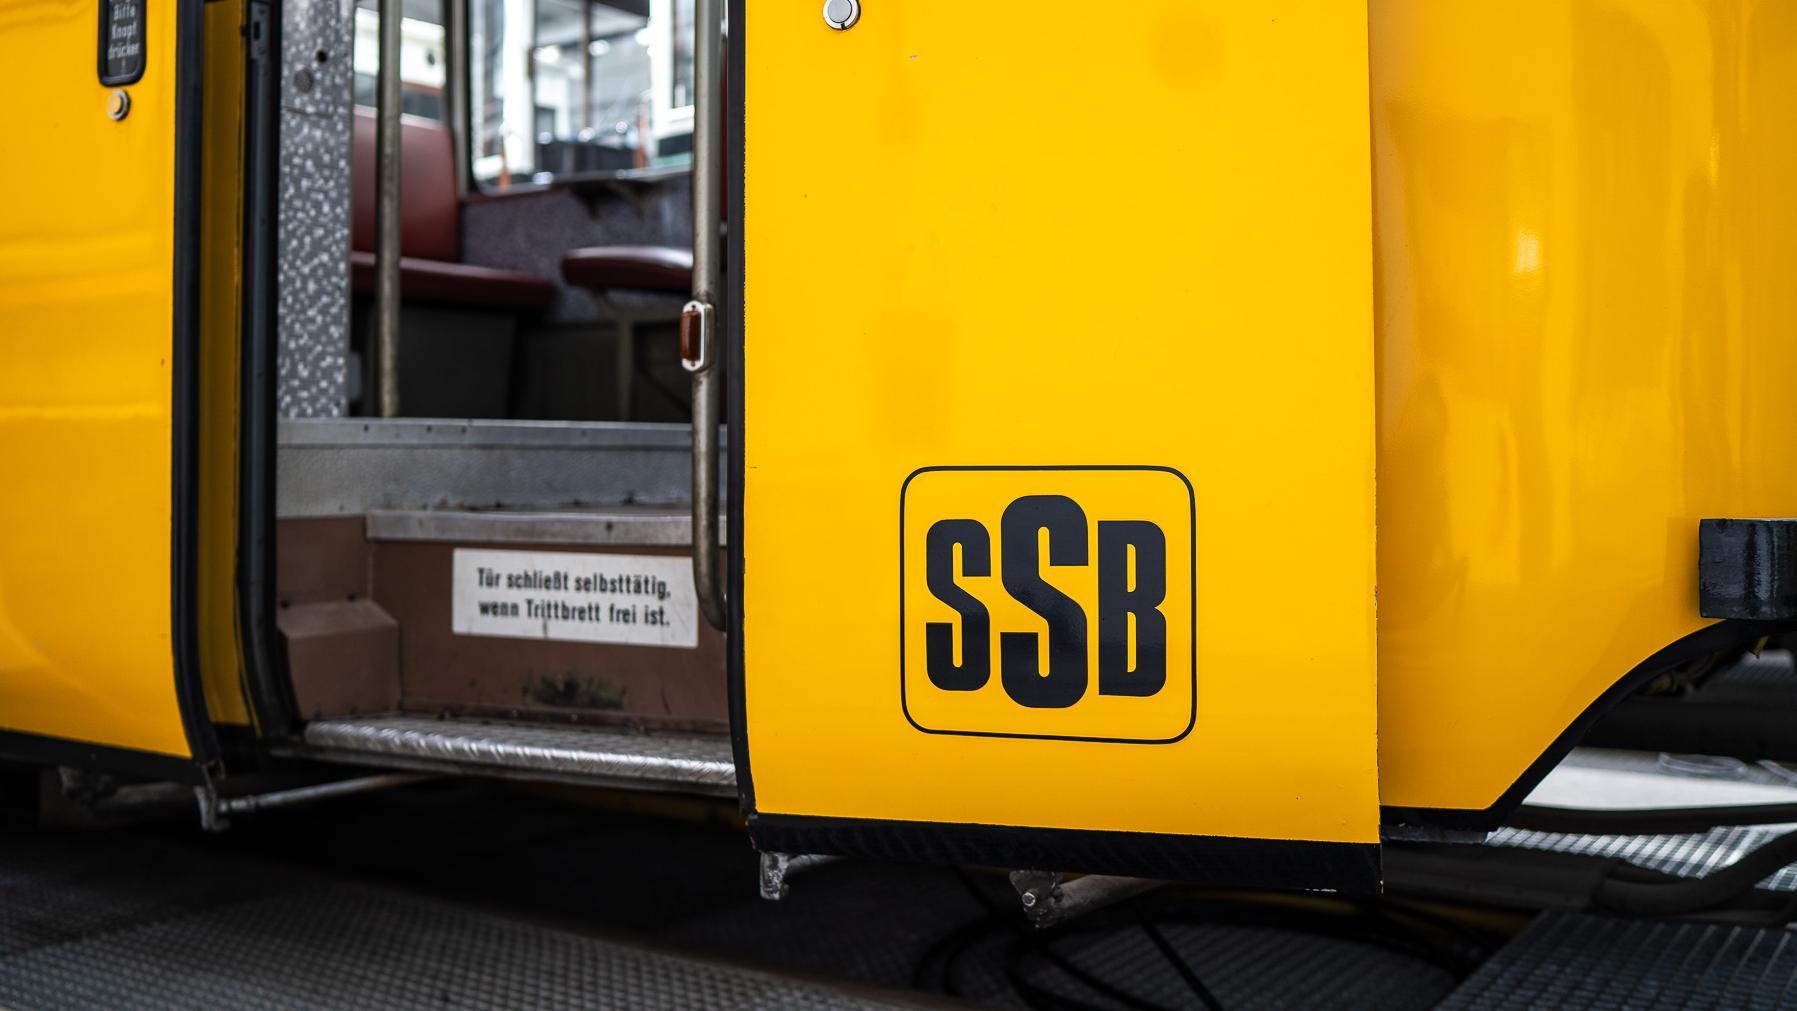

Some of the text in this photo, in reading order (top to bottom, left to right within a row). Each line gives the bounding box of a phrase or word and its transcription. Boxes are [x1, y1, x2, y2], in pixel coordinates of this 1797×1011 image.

[477, 567, 671, 599] Tür schließt selbsttätig,
[478, 598, 670, 627] wenn Trittbrett frei ist.
[926, 495, 1166, 708] SSB
